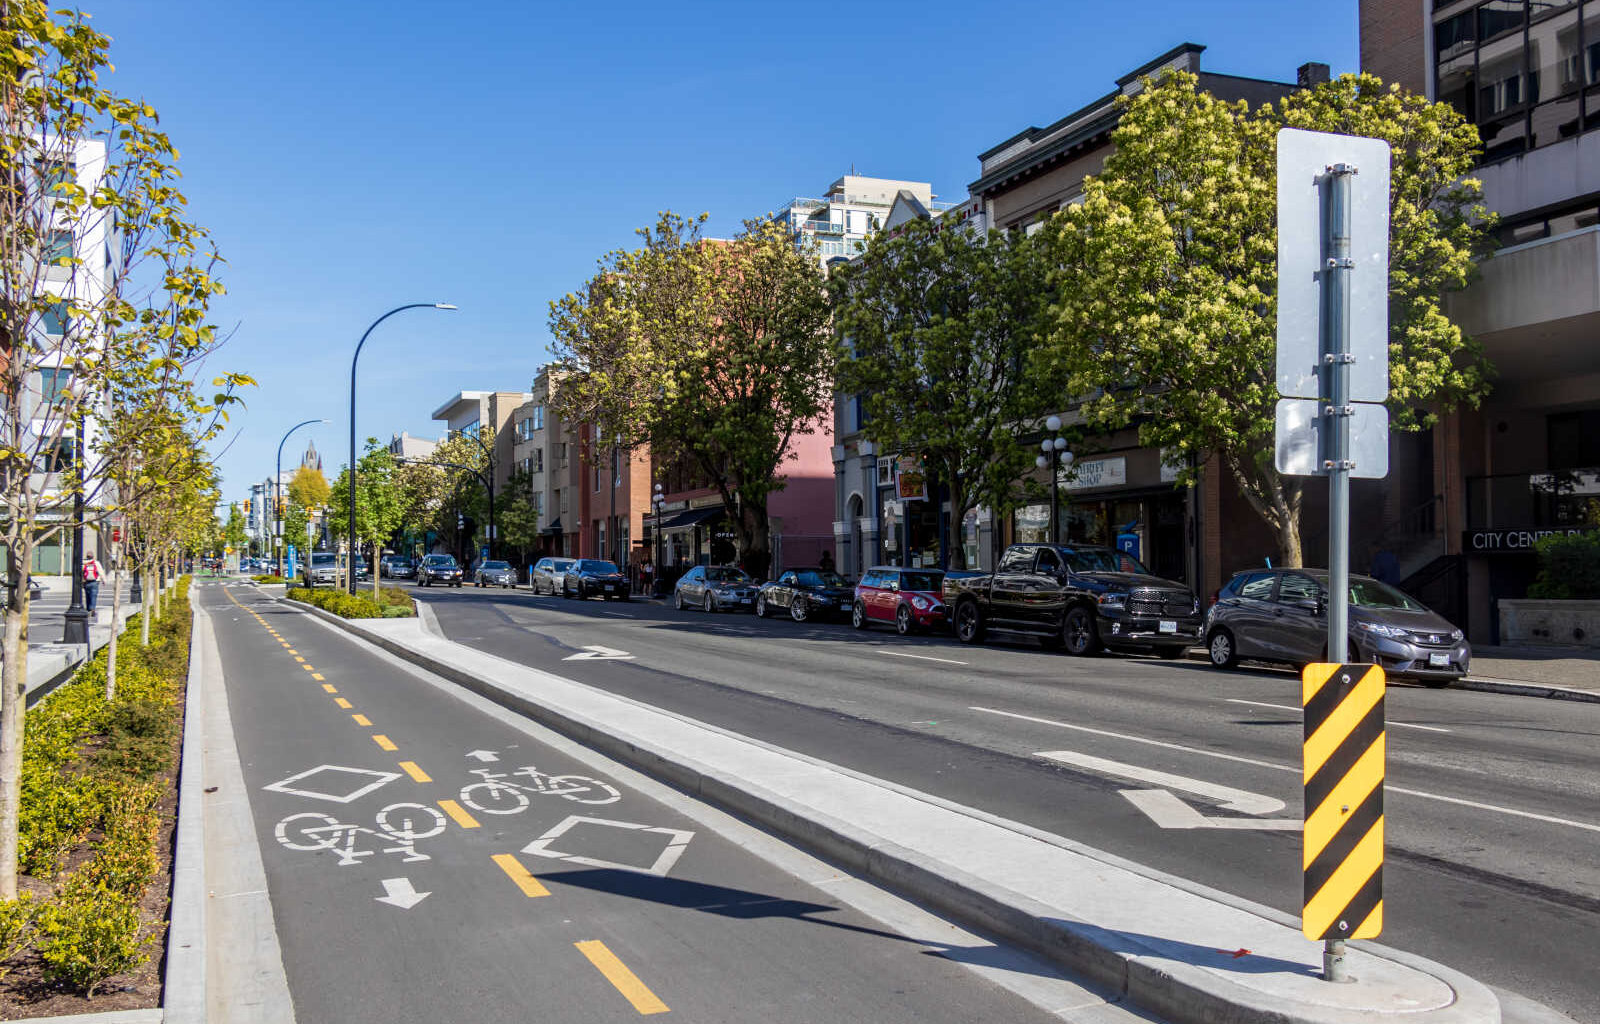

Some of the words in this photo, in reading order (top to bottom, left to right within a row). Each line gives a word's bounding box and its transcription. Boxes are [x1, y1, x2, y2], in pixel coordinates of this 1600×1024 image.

[1079, 472, 1102, 487] SHOP
[1124, 540, 1133, 553] P
[1472, 532, 1503, 549] CITY
[1506, 530, 1563, 548] CENTR
